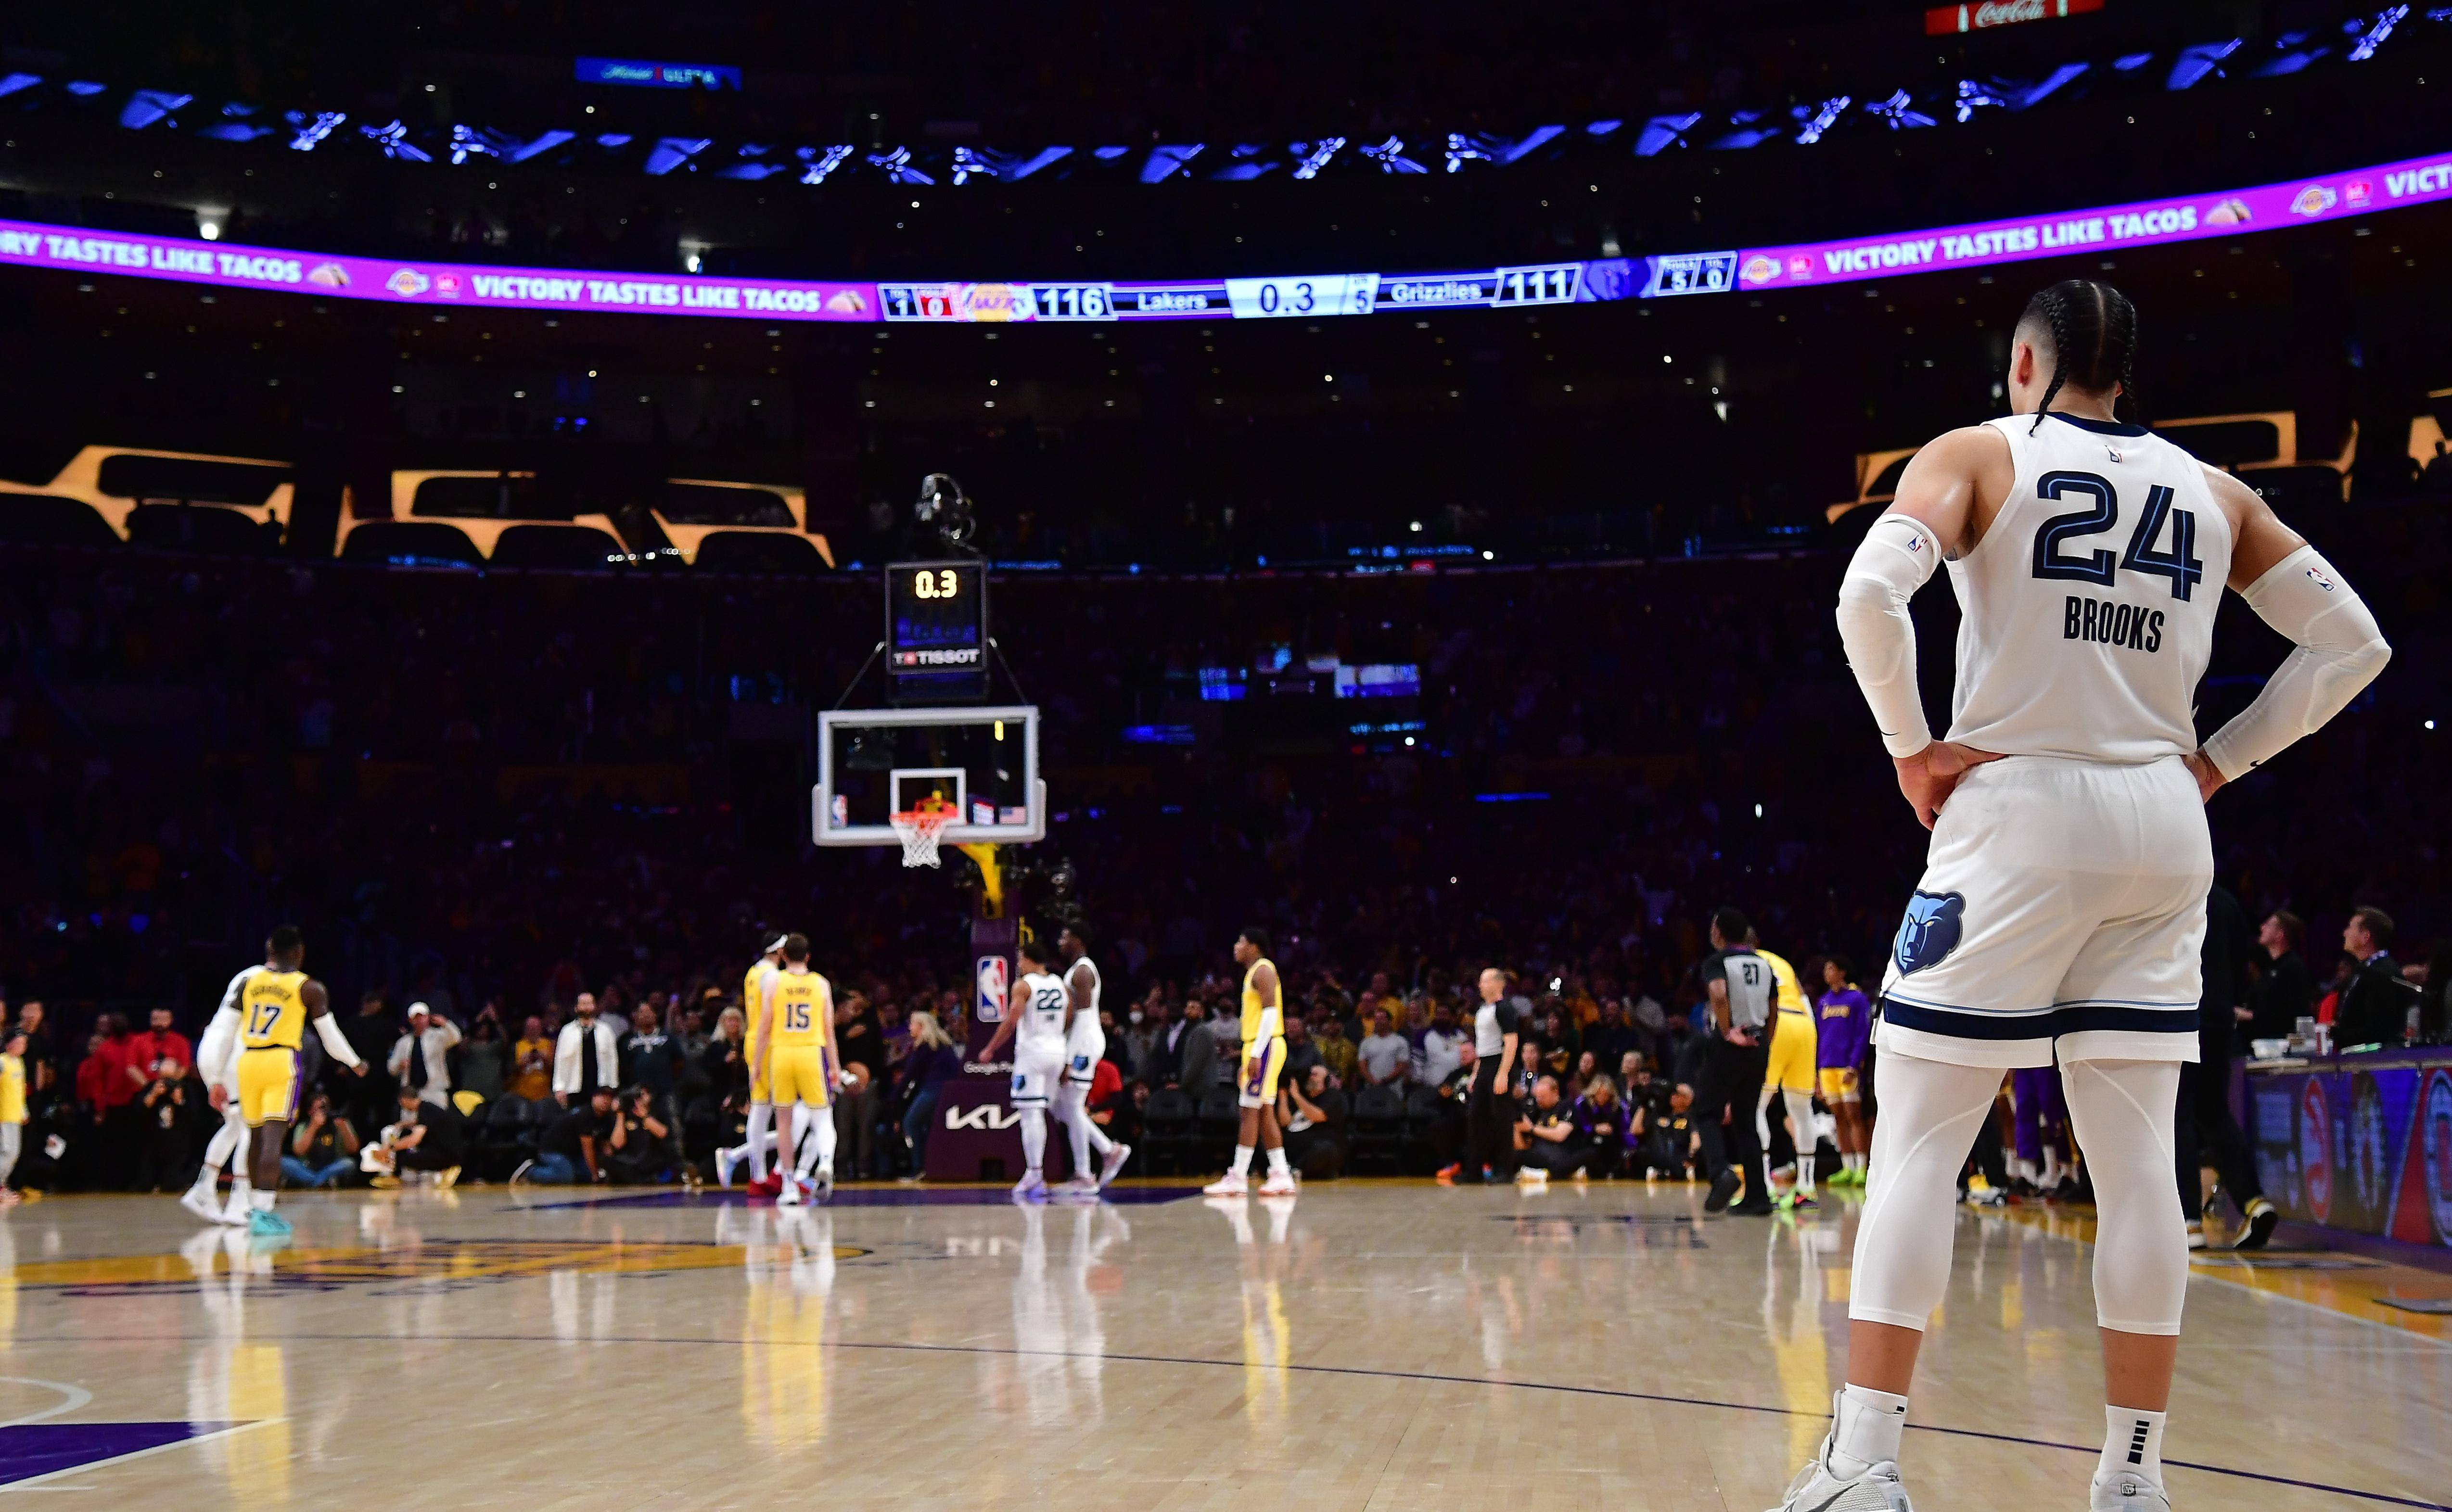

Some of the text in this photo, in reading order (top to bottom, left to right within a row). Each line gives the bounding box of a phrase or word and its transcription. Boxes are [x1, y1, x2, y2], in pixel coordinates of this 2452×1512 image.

[1824, 206, 2197, 274] VICTORY TASTES LIKE TACOS
[0, 230, 303, 283] RY TASTES LIKE TACOS
[472, 274, 821, 313] VICTORY TASTES LIKE TACOS
[1391, 281, 1482, 303] Grizzlies
[1508, 269, 1567, 302] 111
[1707, 268, 1723, 290] 0
[895, 298, 944, 317] 1 0
[1041, 288, 1104, 318] 116
[1137, 292, 1208, 311] Lakers
[1261, 283, 1314, 313] 0.3
[1356, 290, 1368, 312] 5
[2032, 470, 2203, 603] 24
[916, 570, 957, 598] 0.3
[2063, 596, 2165, 653] BROOKS
[917, 648, 981, 665] TISSOT
[1743, 963, 1758, 985] 27
[1037, 989, 1063, 1010] 22
[248, 1004, 282, 1038] 17
[785, 1003, 811, 1032] 15
